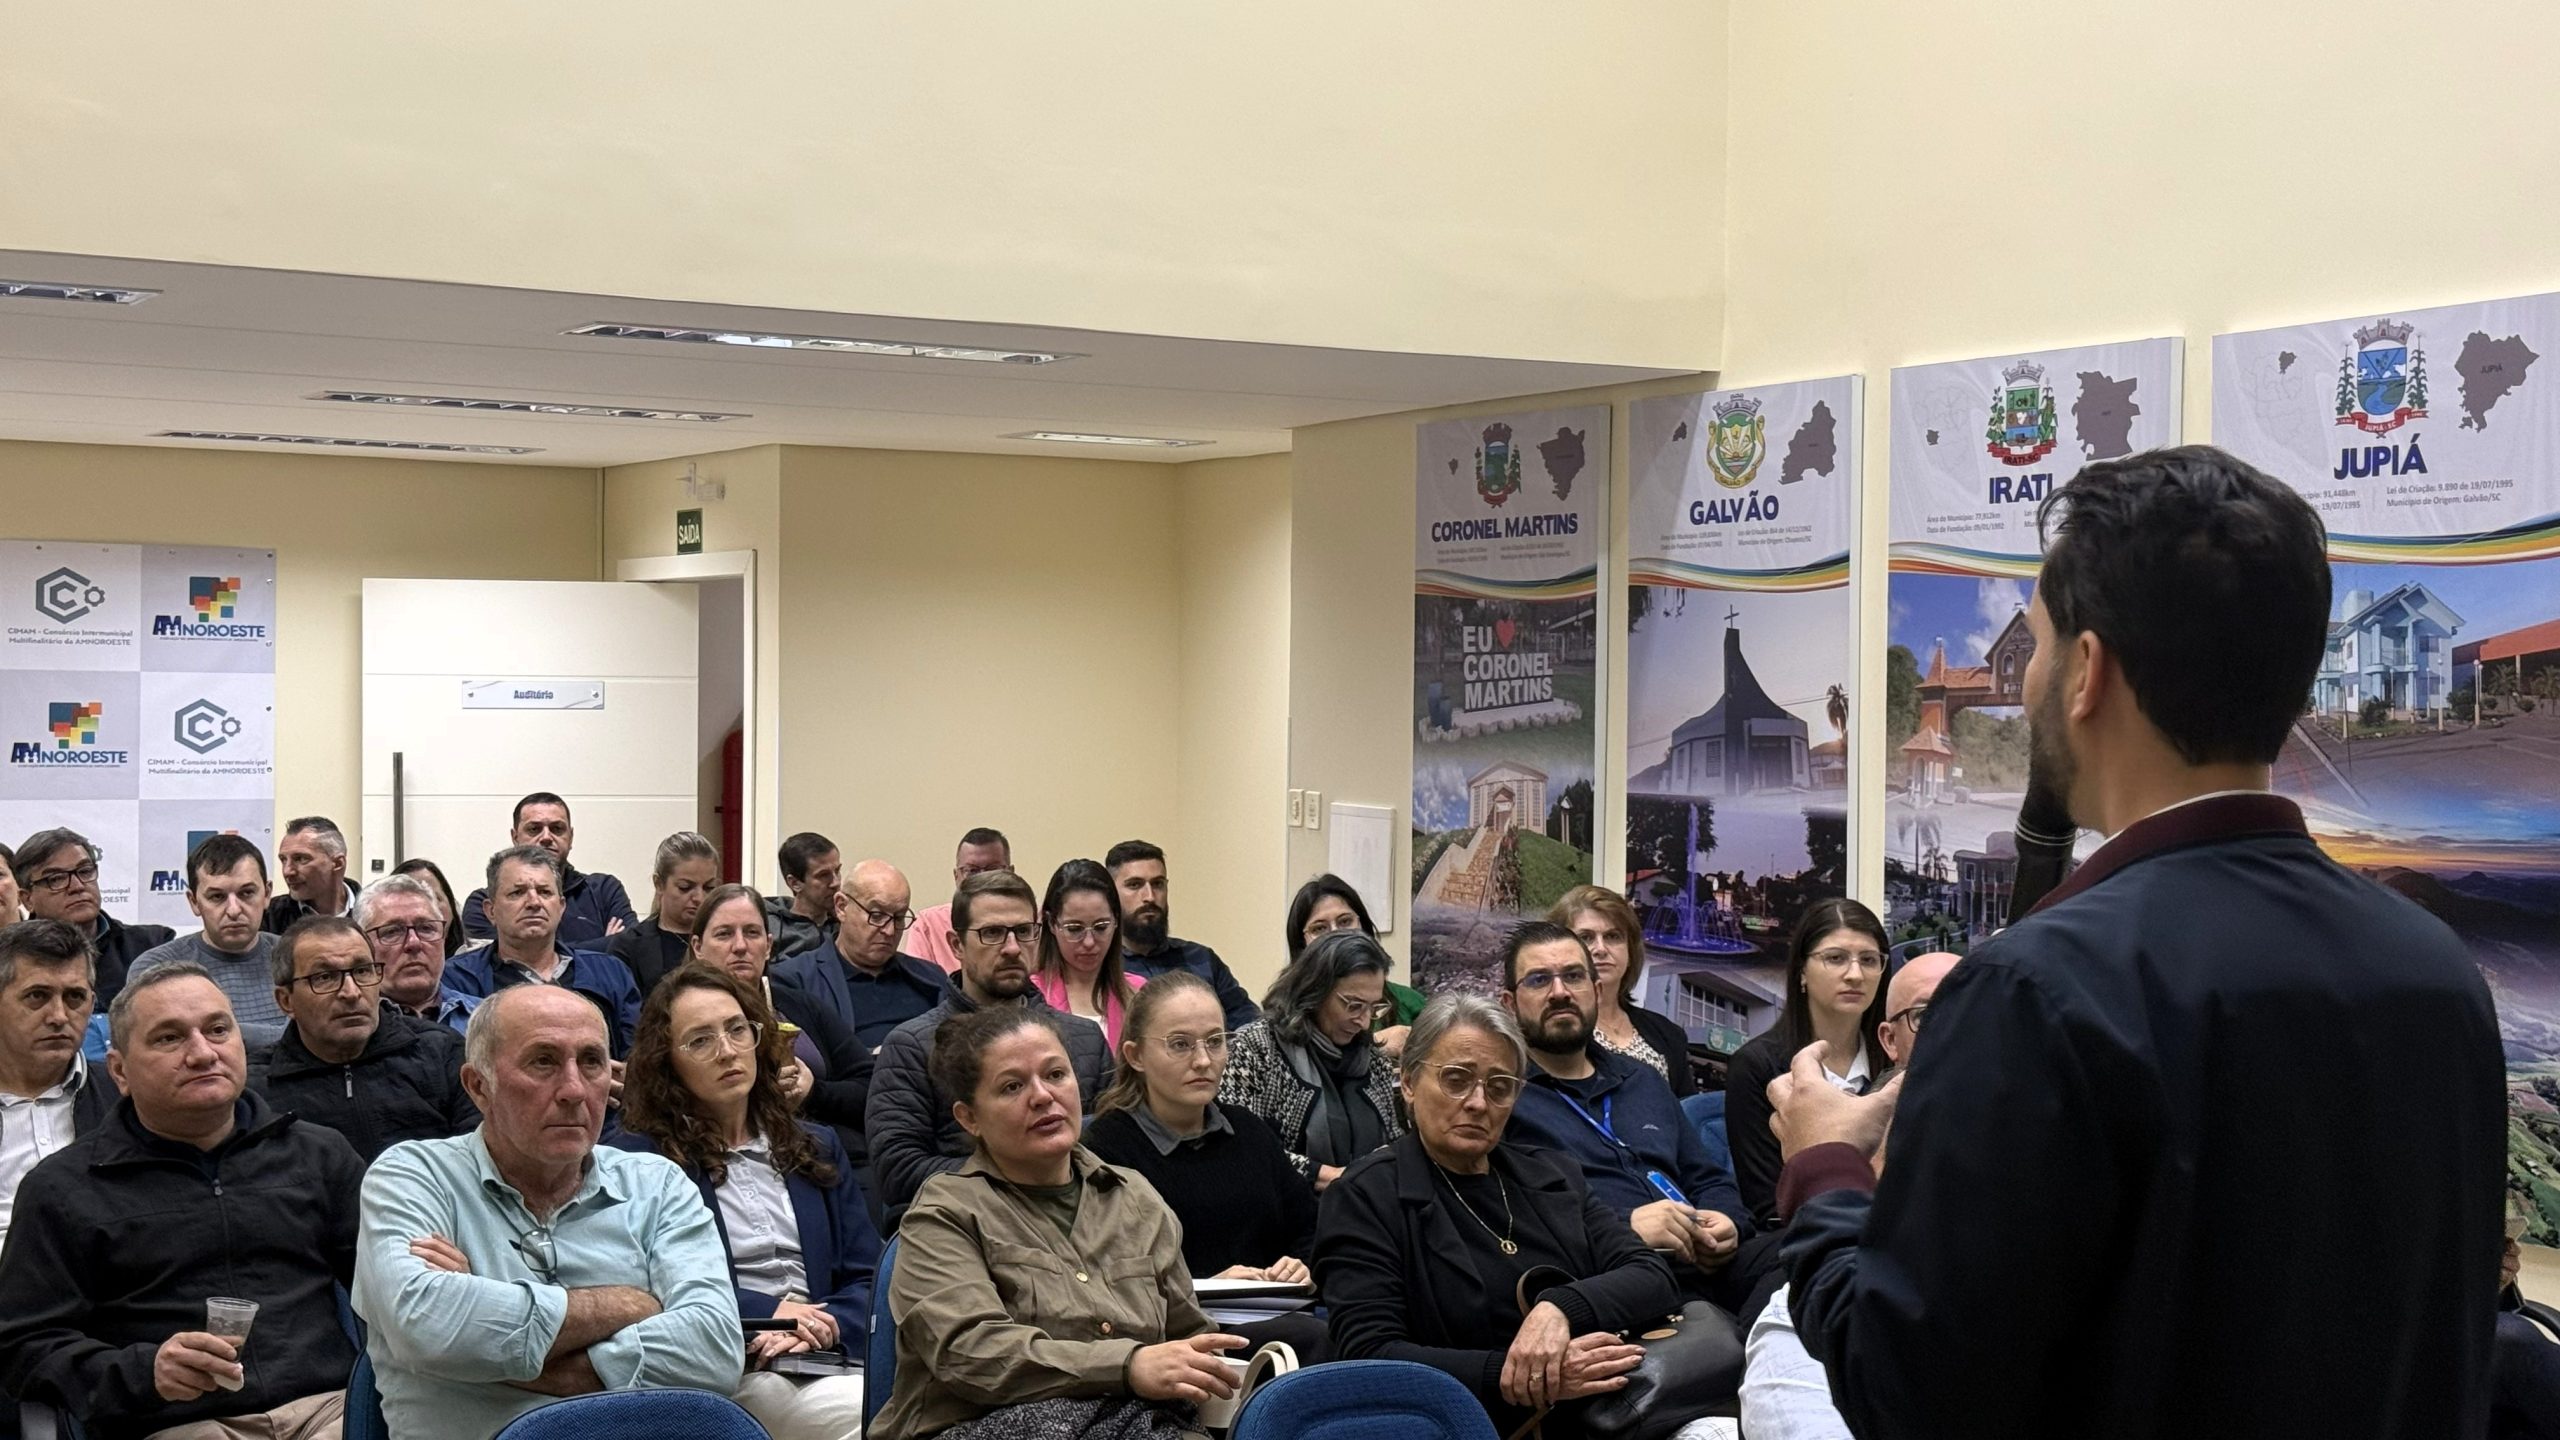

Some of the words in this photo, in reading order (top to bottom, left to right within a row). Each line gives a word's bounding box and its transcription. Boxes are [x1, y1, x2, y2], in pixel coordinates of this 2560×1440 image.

[2334, 432, 2428, 480] JUPIÁ
[1989, 473, 2053, 504] IRATI
[2386, 486, 2397, 494] Lei
[2398, 486, 2407, 494] de
[2460, 481, 2469, 490] de
[2423, 497, 2432, 505] de
[1690, 489, 1779, 525] GALVÃO
[679, 519, 701, 545] SAÍDA
[1431, 518, 1502, 542] CORONEL
[1505, 513, 1578, 538] MARTINS
[152, 615, 265, 637] AMNOROESTE
[1463, 626, 1492, 653] EU
[1463, 652, 1553, 681] CORONEL
[513, 689, 554, 700] Auditório
[1464, 677, 1553, 709] MARTINS
[10, 742, 128, 764] AMNOROESTE
